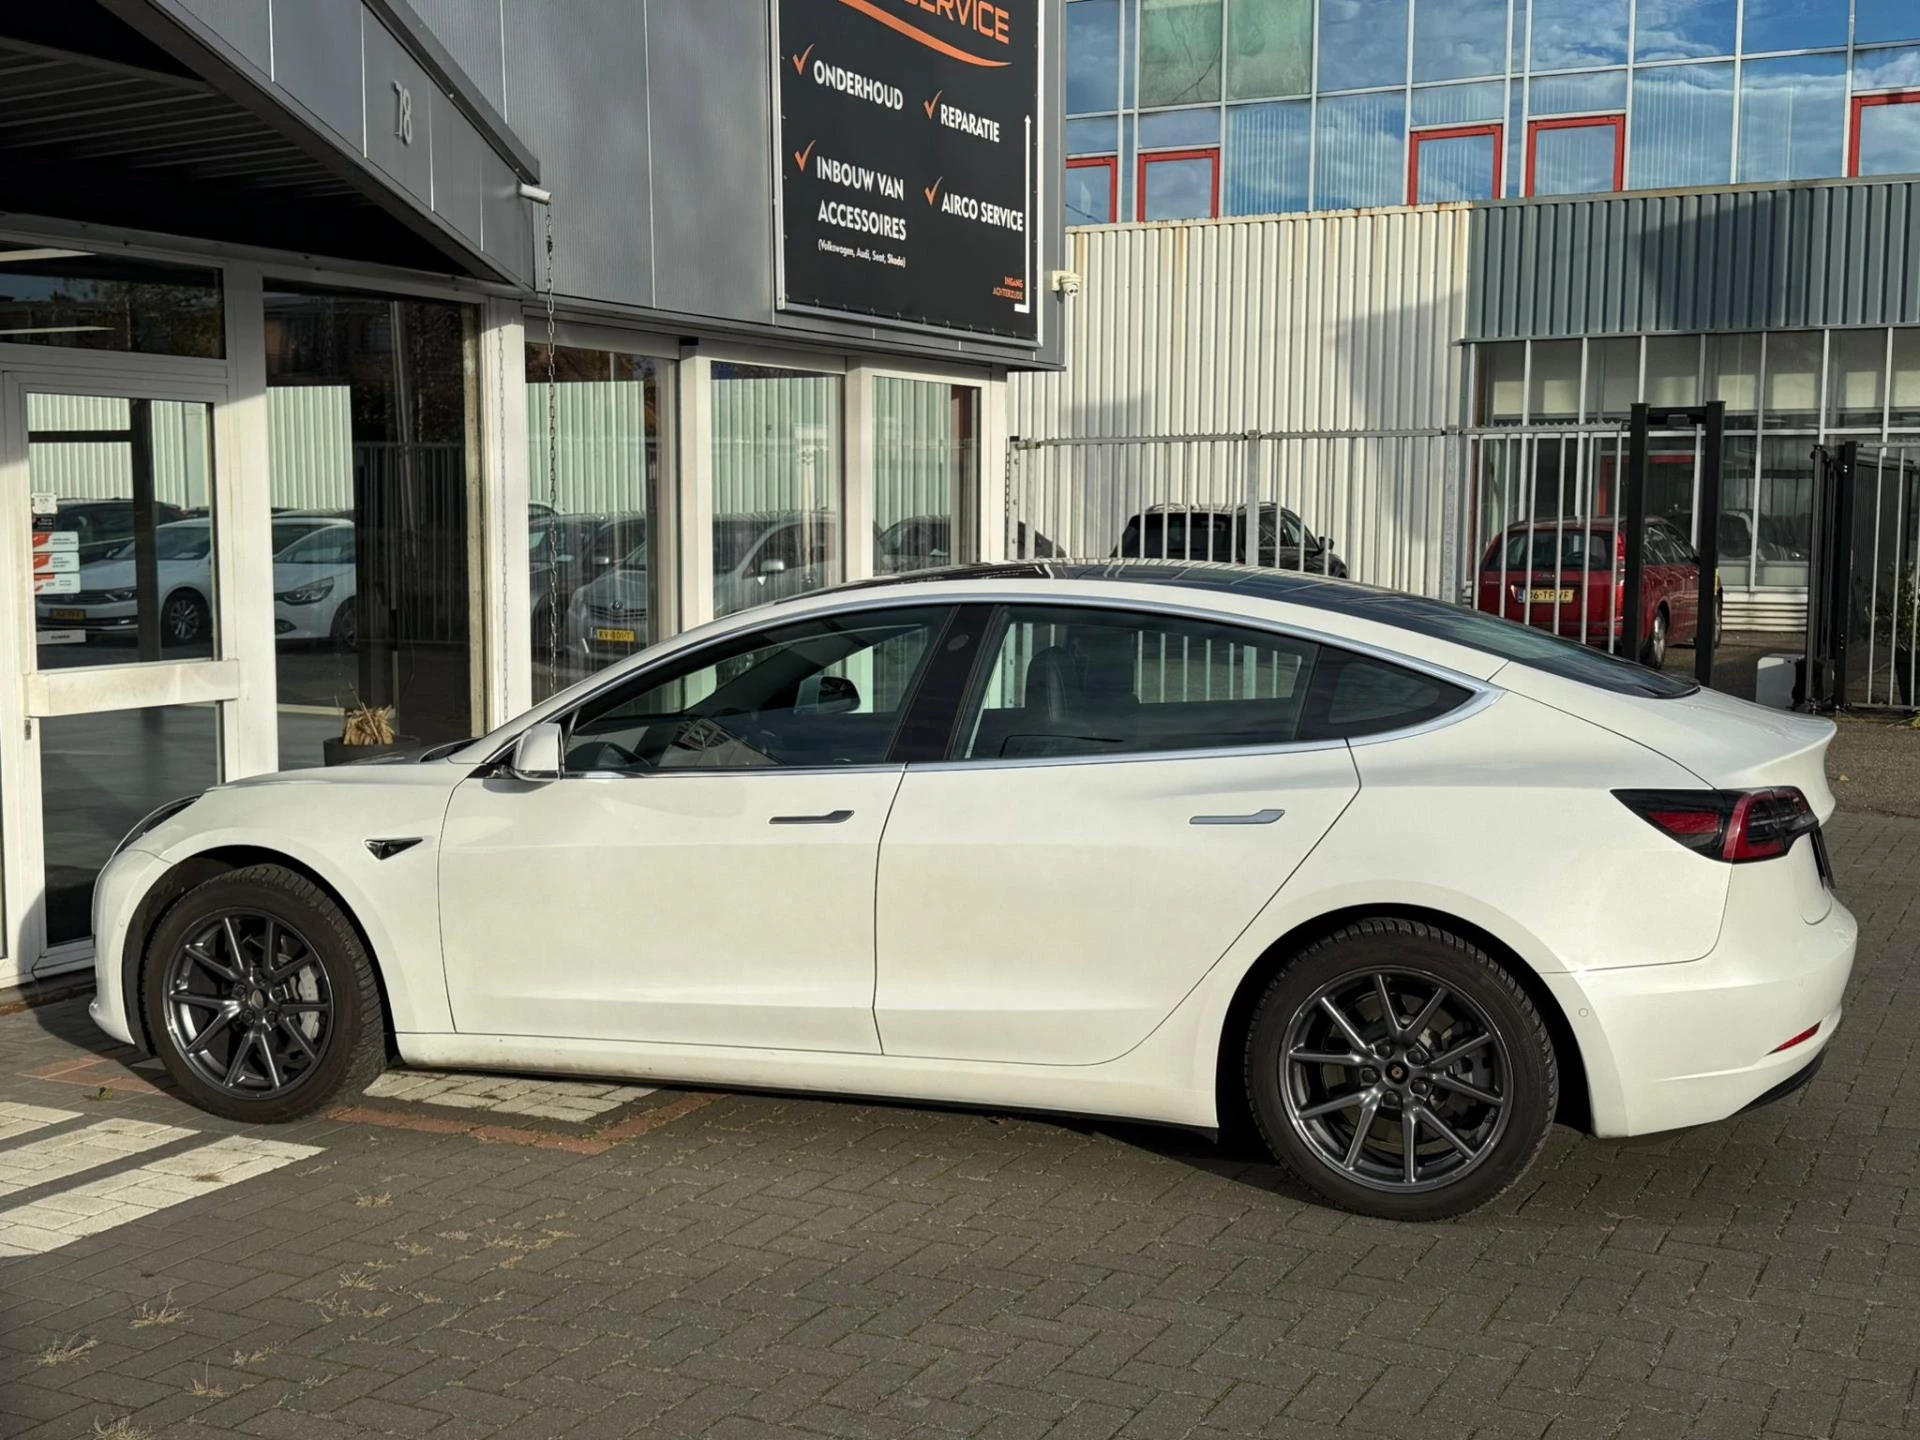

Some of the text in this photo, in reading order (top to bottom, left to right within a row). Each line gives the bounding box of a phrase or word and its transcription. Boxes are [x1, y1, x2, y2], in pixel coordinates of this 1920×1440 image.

[904, 0, 1010, 45] RVICE
[813, 60, 904, 111] ONDERHOUD
[393, 79, 413, 145] 18
[940, 103, 1000, 143] REPARATIE
[816, 155, 904, 201] INBOUW VAN
[817, 199, 907, 241] ACCESSOIRES
[941, 192, 1024, 232] AIRCO SERVICE
